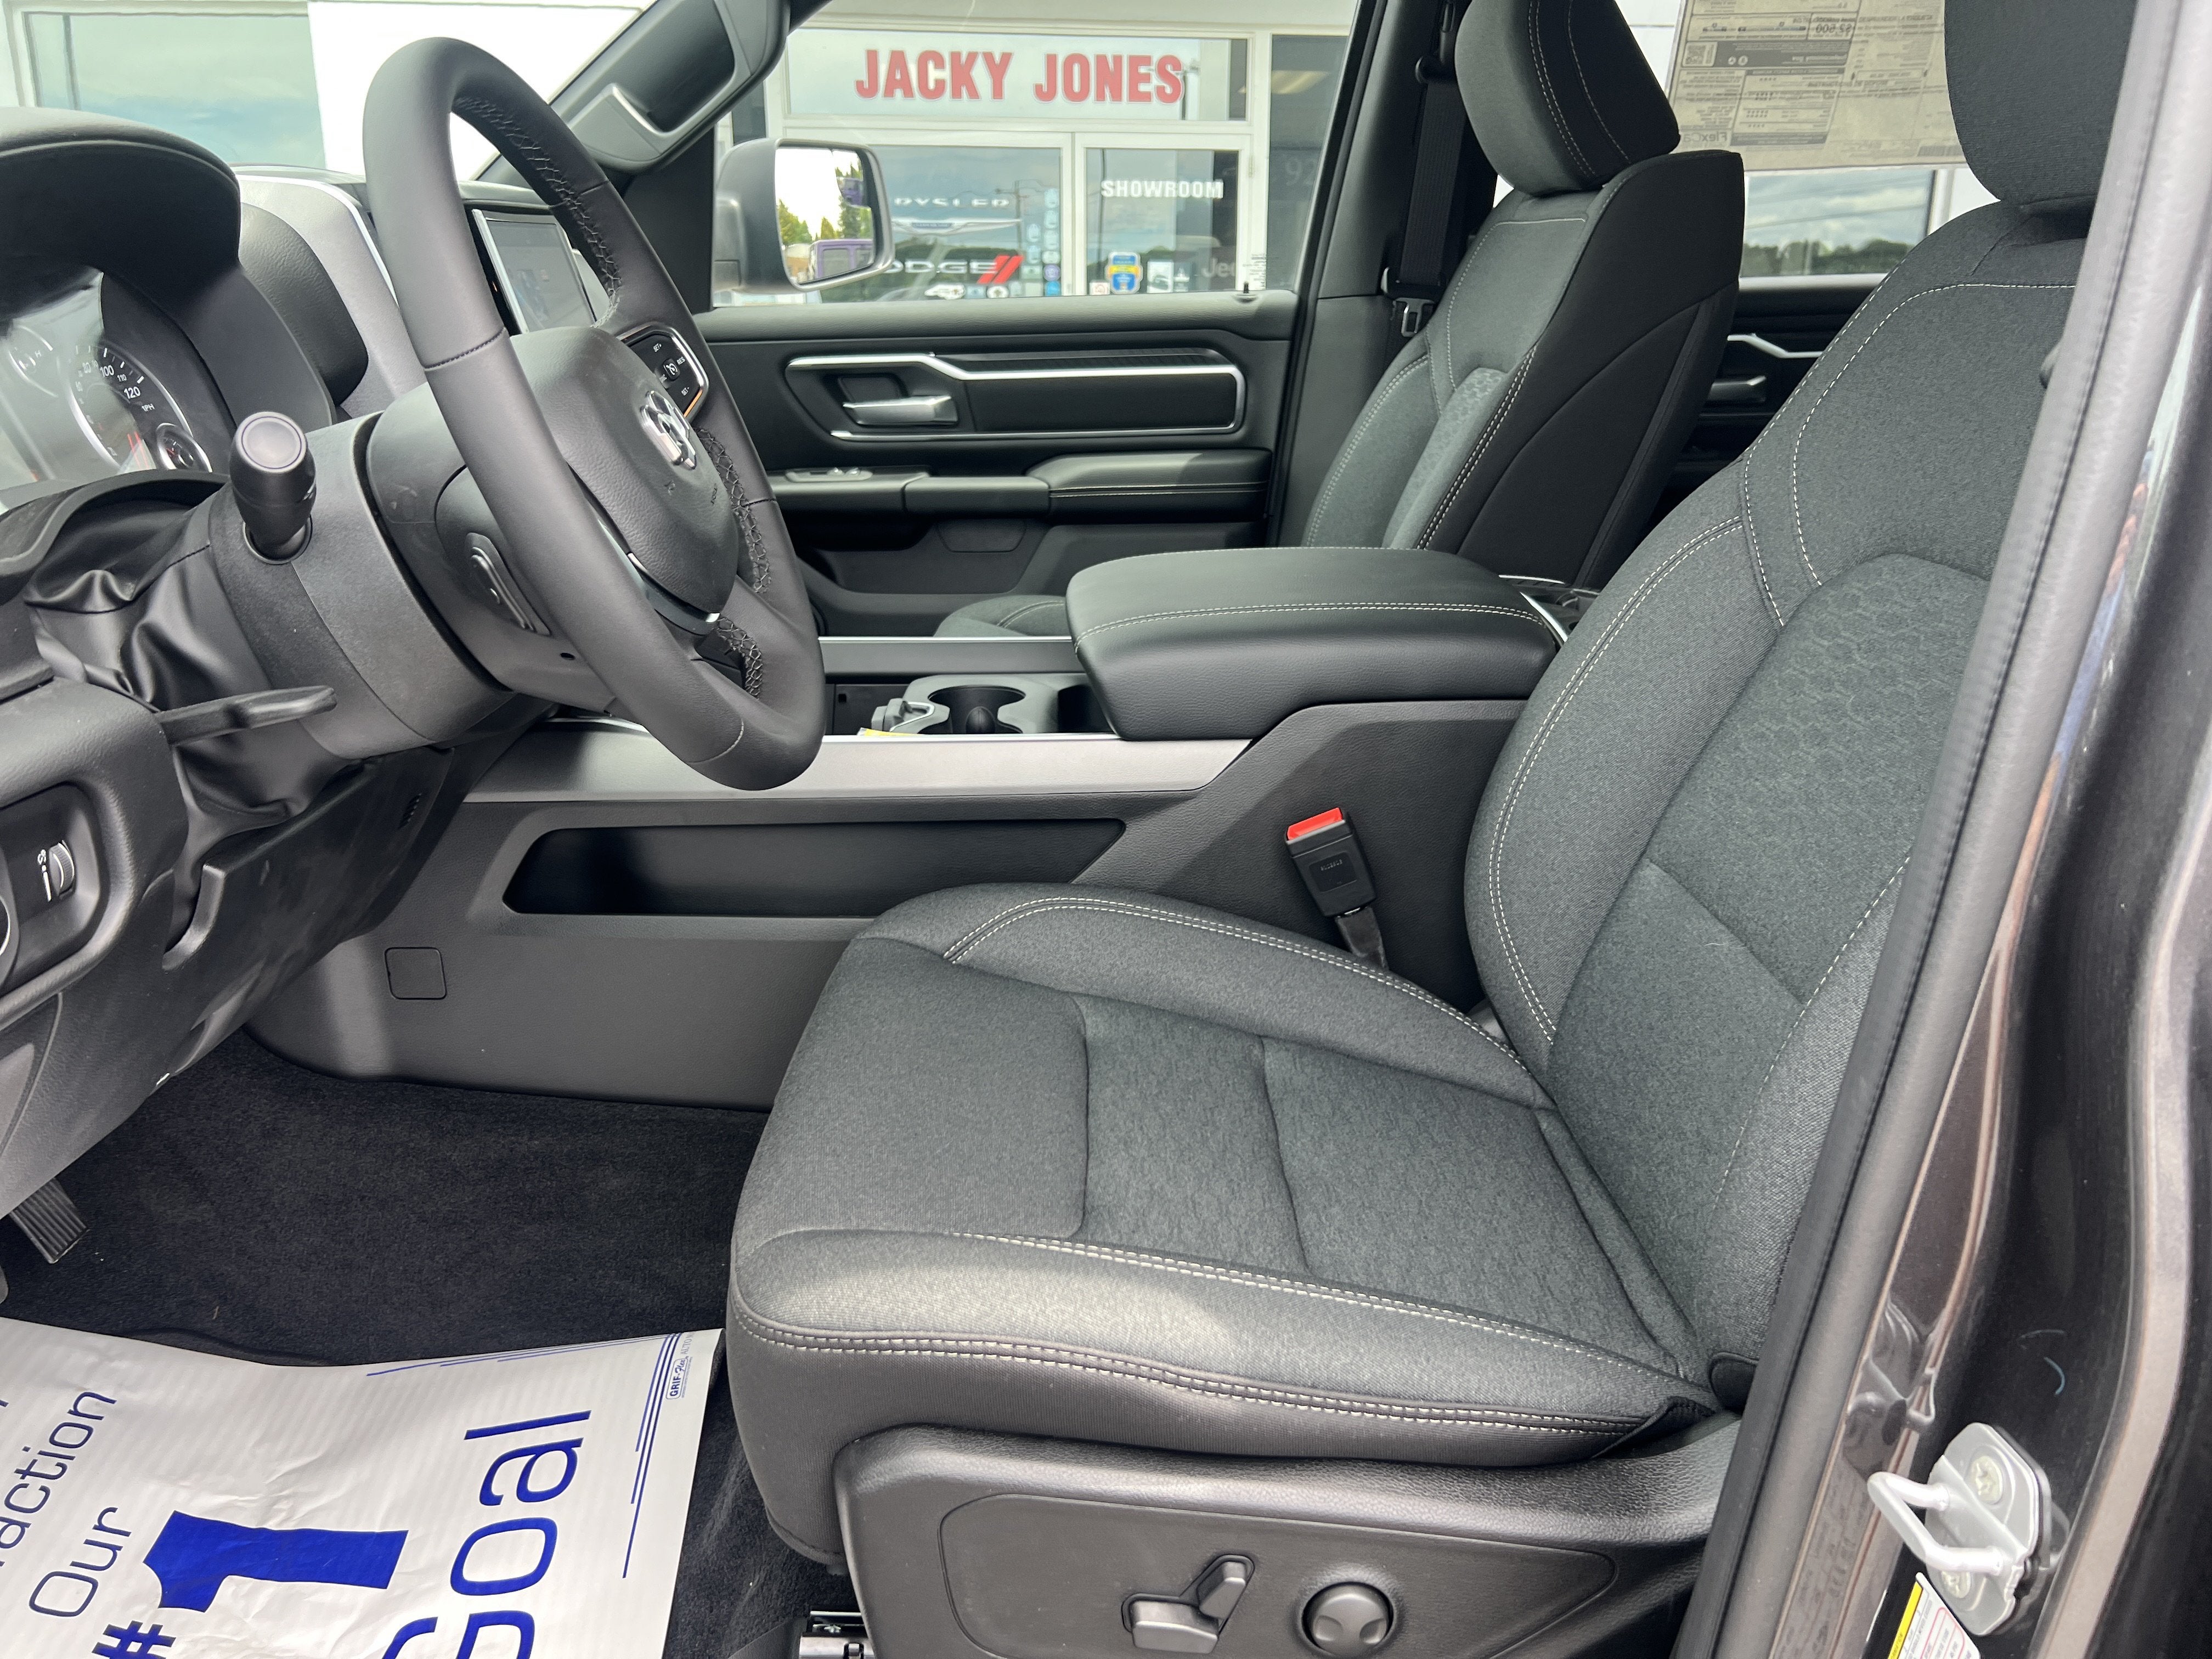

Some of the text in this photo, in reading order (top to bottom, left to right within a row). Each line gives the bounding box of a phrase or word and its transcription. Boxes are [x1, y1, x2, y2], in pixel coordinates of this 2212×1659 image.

[855, 49, 1183, 104] JACKY JONES
[1101, 179, 1223, 198] SHOWROOM
[884, 259, 997, 274] DGE
[100, 365, 115, 377] 100
[117, 374, 127, 382] 110
[123, 386, 141, 399] 120
[680, 1339, 692, 1355] AUTO
[0, 1391, 116, 1566] action
[29, 1506, 132, 1618] Our
